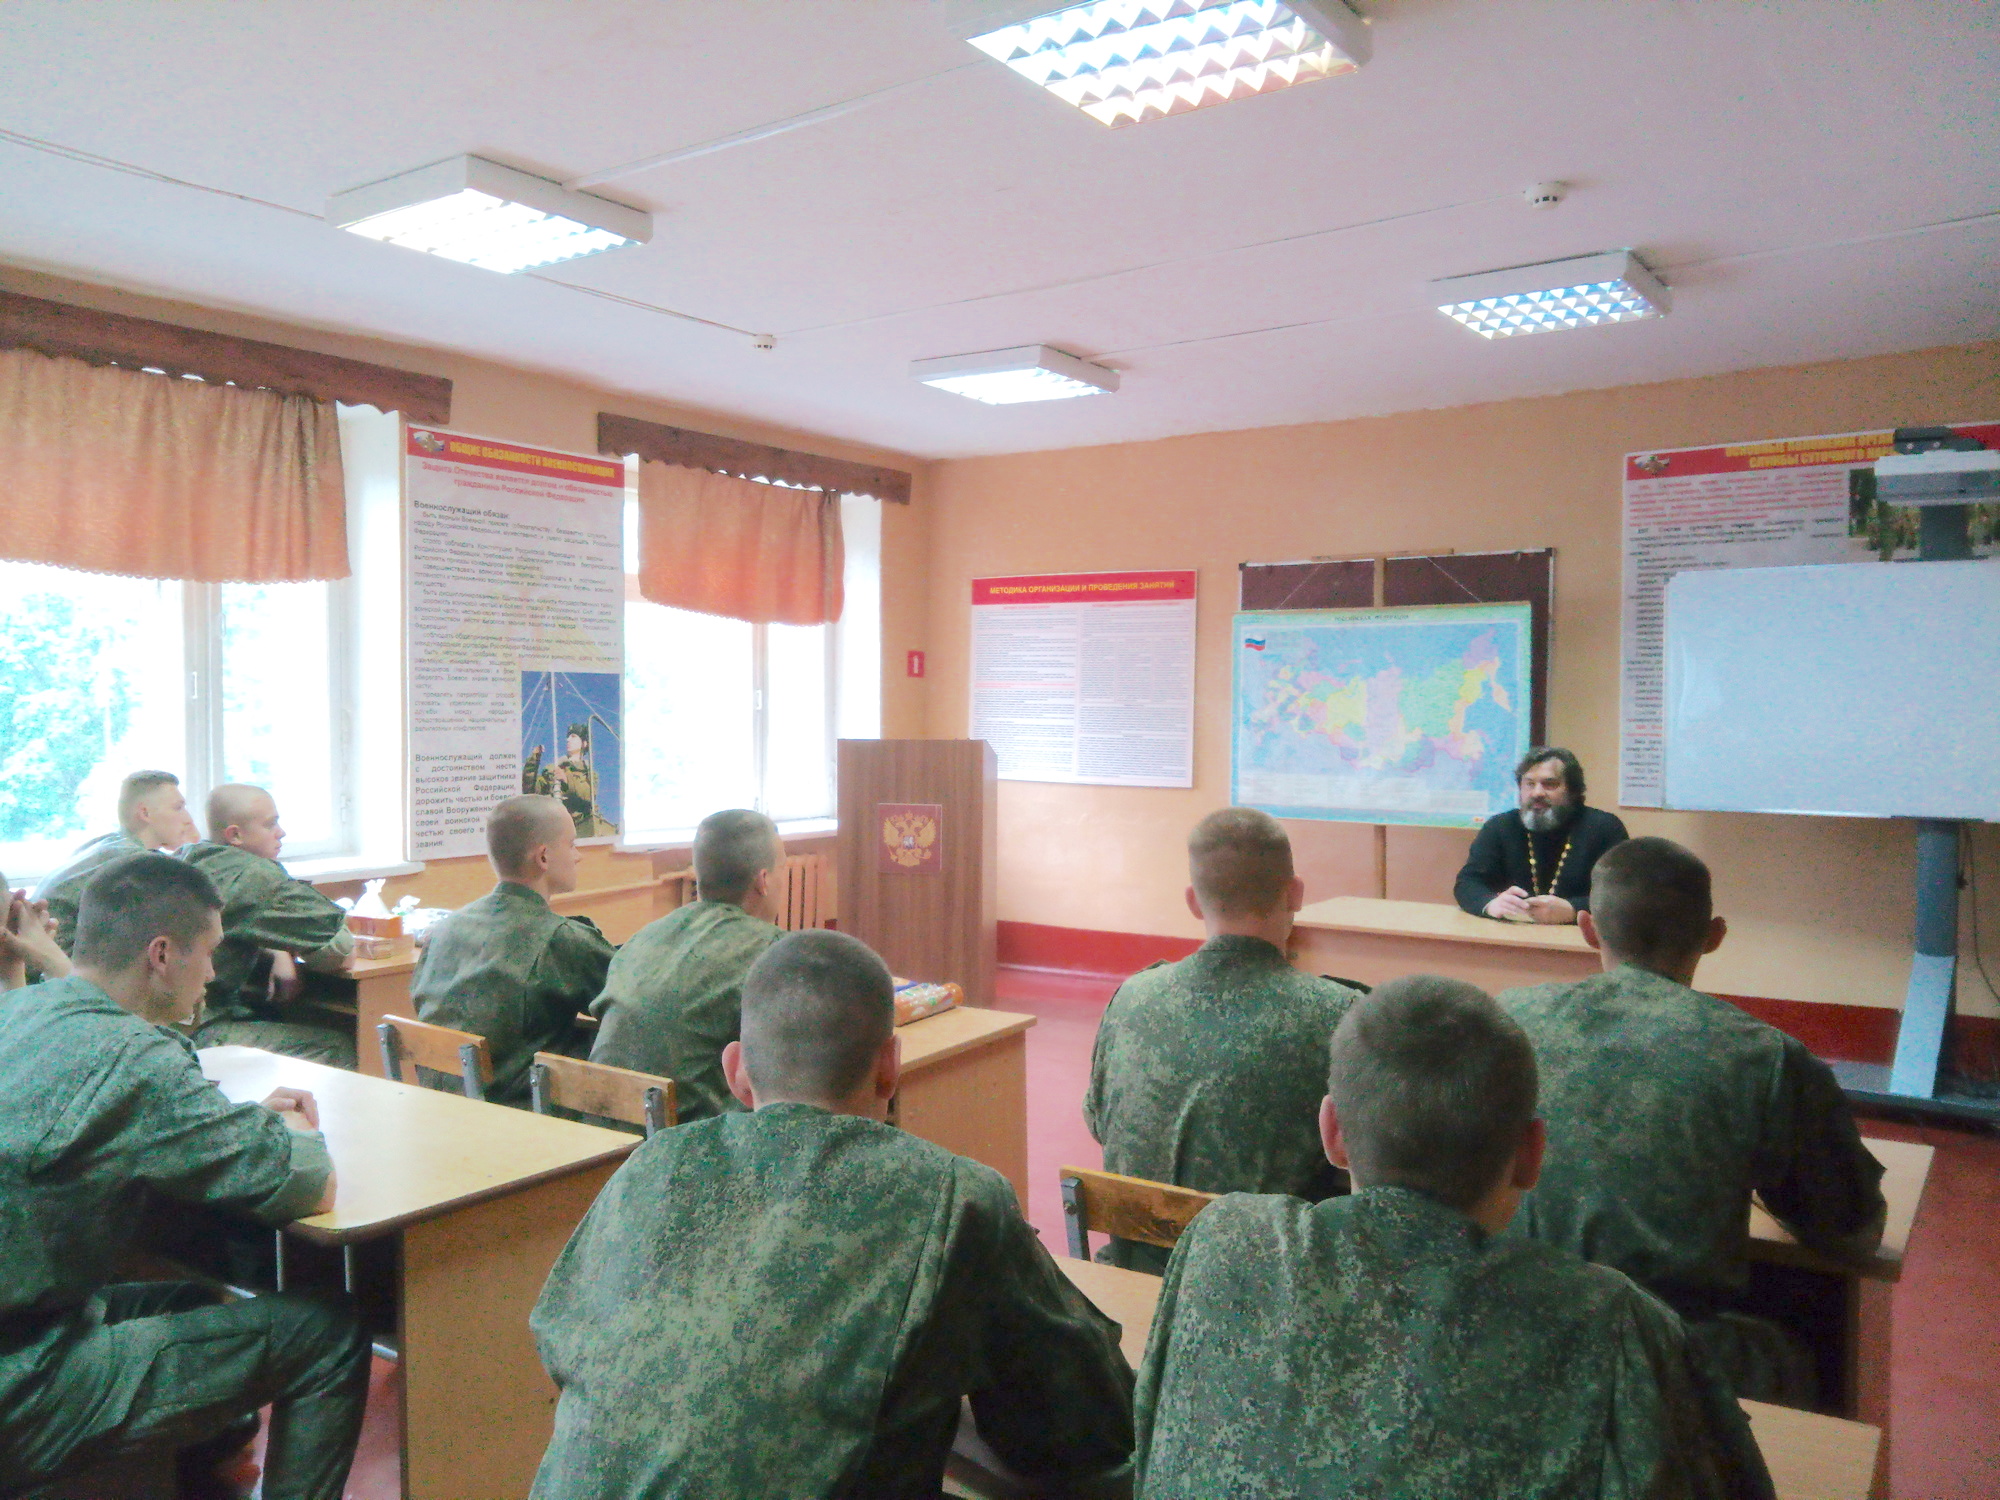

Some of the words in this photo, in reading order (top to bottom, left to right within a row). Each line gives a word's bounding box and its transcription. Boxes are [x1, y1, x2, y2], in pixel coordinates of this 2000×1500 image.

[414, 501, 481, 515] Военнослужащий
[990, 586, 1027, 594] МЕТОДИКА
[1029, 584, 1080, 593] ОРГАНИЗАЦИИ
[1082, 584, 1087, 592] И
[1088, 582, 1138, 591] ПРОВЕДЕНИЯ
[1140, 580, 1175, 590] ЗАНЯТИЙ
[415, 754, 482, 762] Военнослужащий
[489, 753, 516, 761] должен
[431, 765, 485, 773] достоинством
[415, 776, 448, 784] высокое
[415, 818, 439, 826] своей
[445, 816, 480, 825] воинской
[449, 827, 474, 835] своего
